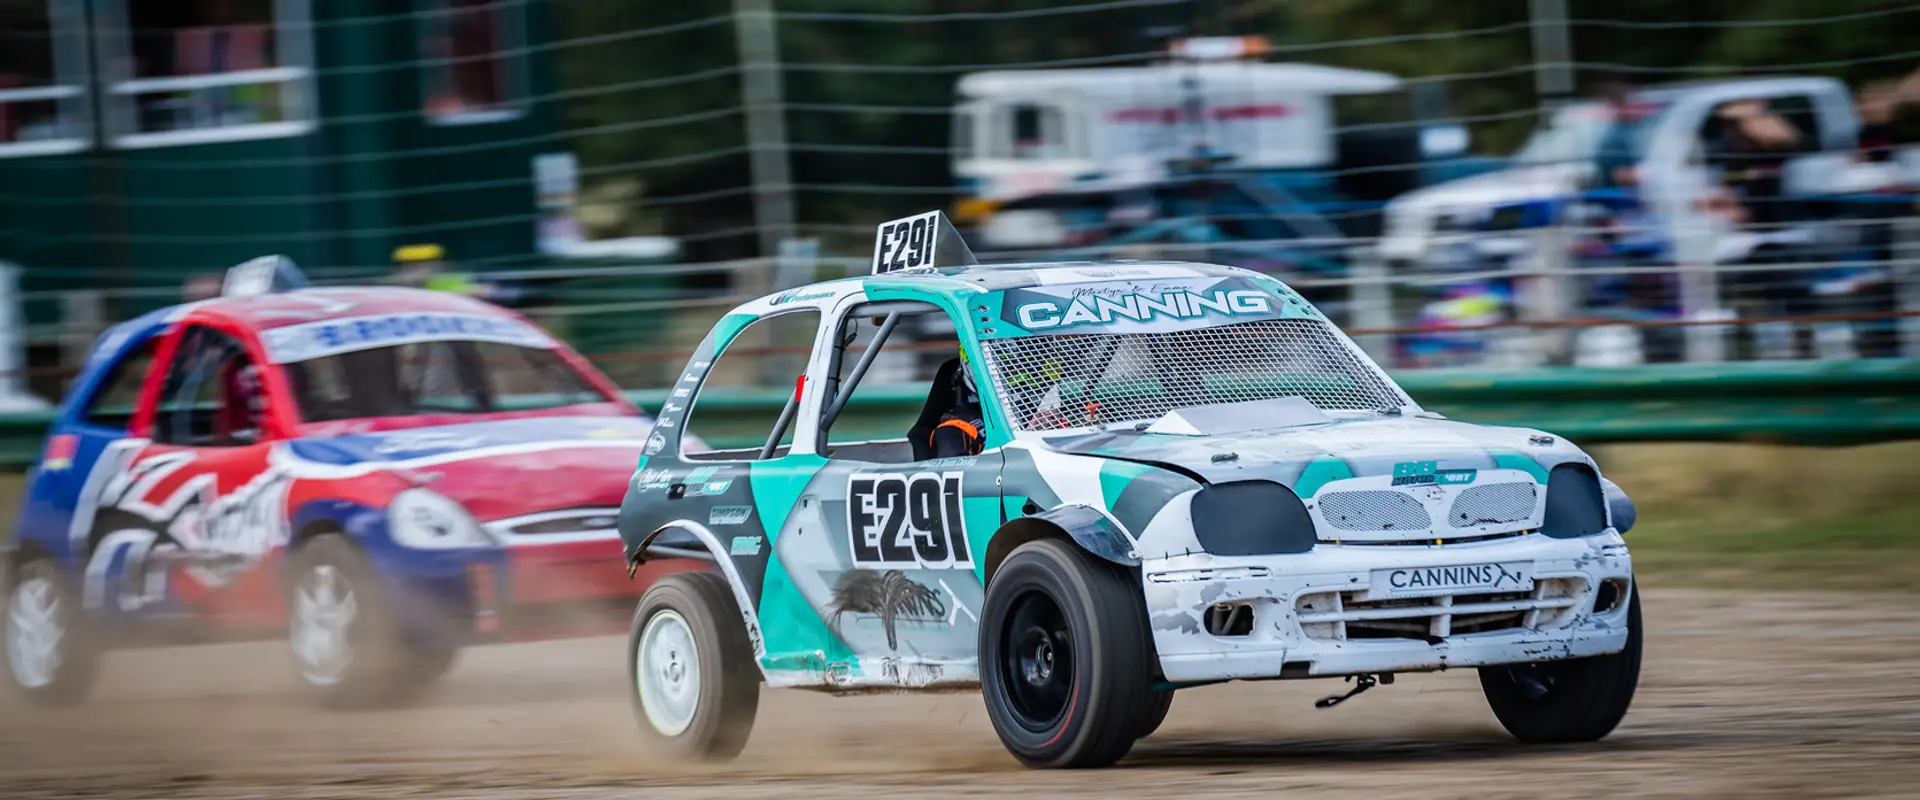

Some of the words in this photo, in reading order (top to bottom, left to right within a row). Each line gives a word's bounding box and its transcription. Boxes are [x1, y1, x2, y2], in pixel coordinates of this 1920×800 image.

[877, 216, 936, 274] E291
[1017, 290, 1271, 329] CANNING
[850, 477, 970, 562] E291
[1390, 565, 1492, 589] CANNINS
